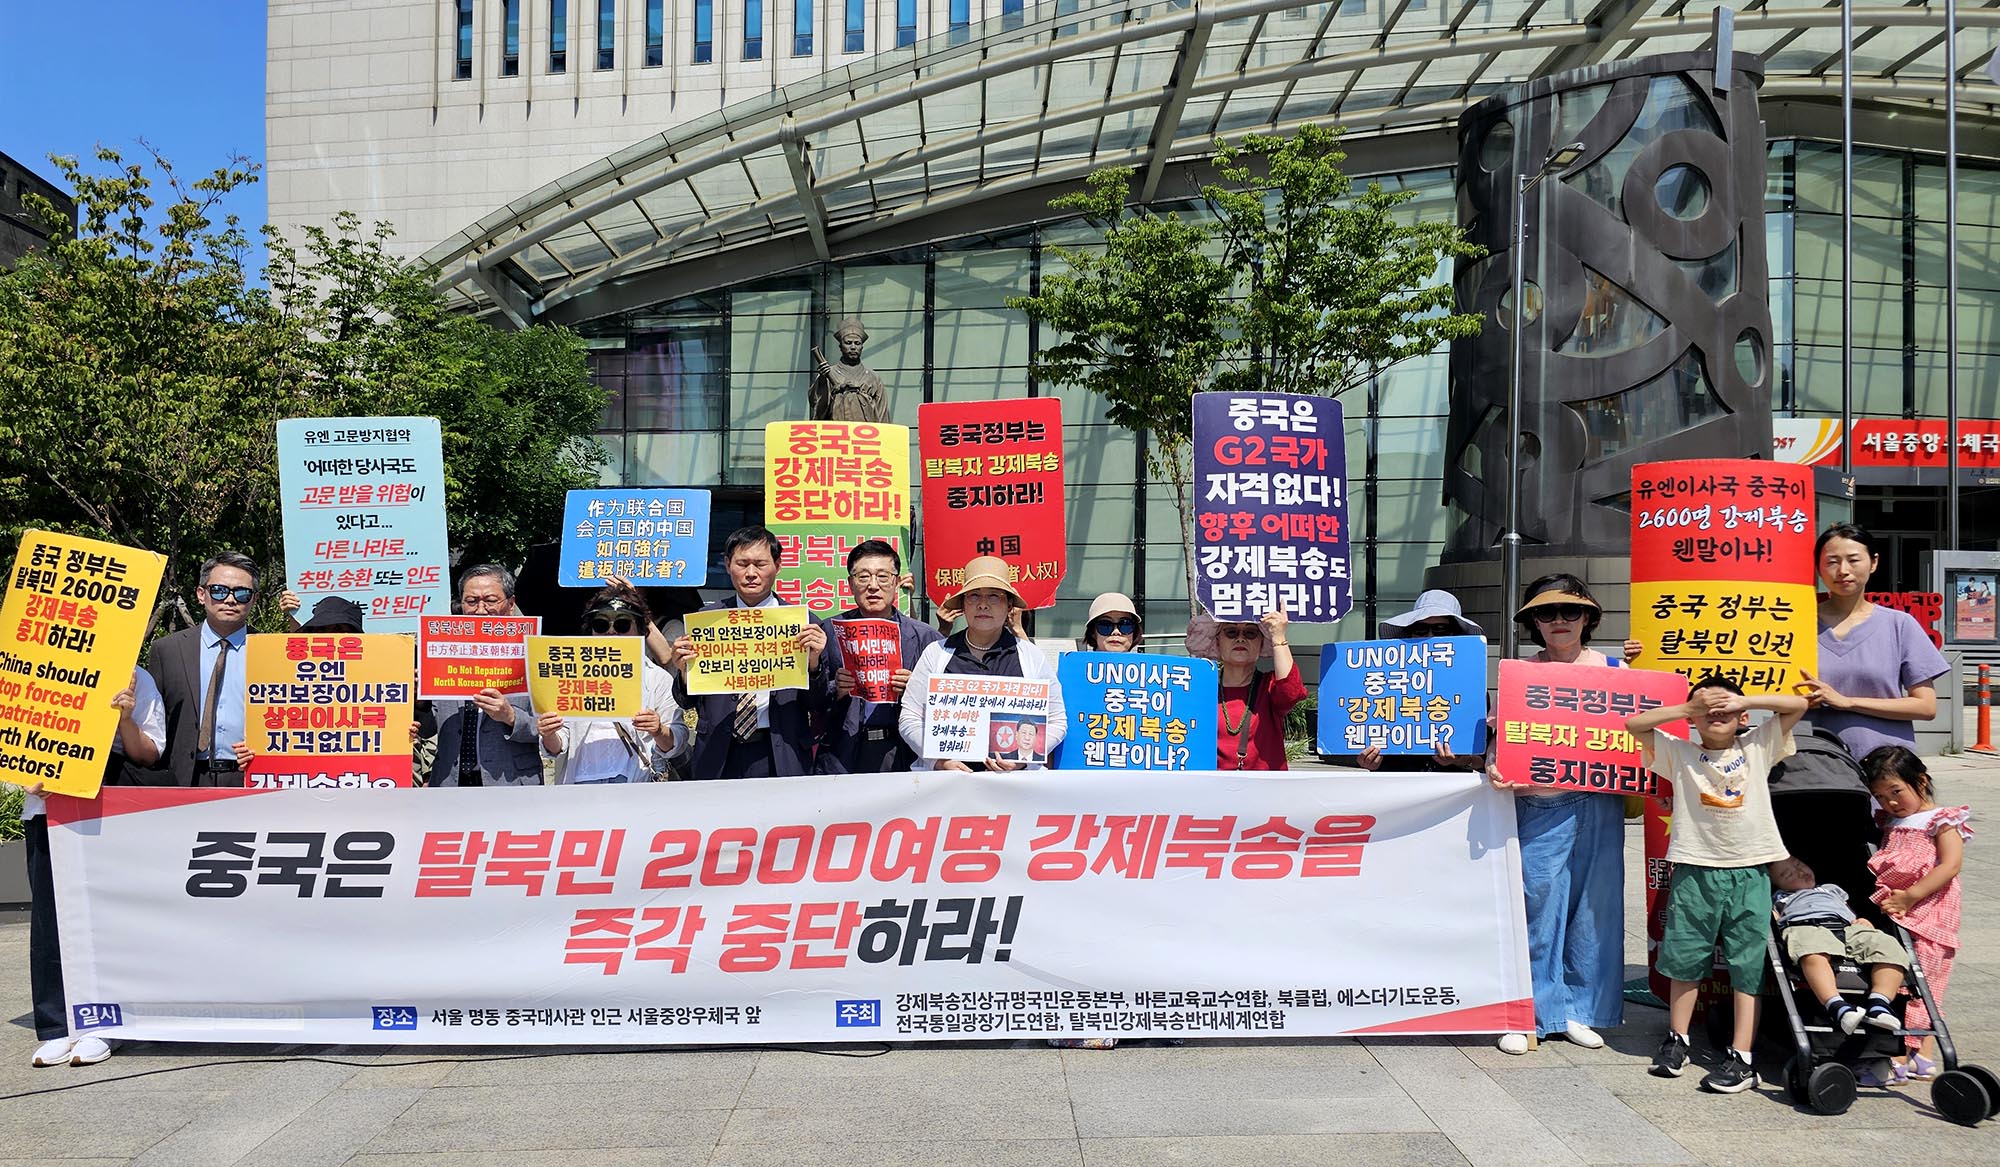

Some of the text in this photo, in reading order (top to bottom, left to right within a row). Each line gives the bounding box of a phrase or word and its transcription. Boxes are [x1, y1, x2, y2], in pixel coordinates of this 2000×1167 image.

[1228, 399, 1318, 433] 중국은
[304, 428, 411, 444] 유엔 고문방지협약
[789, 424, 881, 455] 중국은
[939, 420, 1046, 446] 중국정부는
[1773, 437, 1796, 449] OST
[1863, 432, 2000, 453] 서울중앙체국
[1213, 435, 1328, 470] G2 국가
[355, 458, 417, 475] 당사국도
[774, 458, 893, 489] 강제북송
[925, 453, 1060, 480] 탈북자 강제북송
[299, 484, 425, 506] 고문 받을 위험이
[947, 484, 1044, 510] 중지하라!
[1205, 473, 1341, 508] 자격없다!
[1636, 476, 1807, 502] 유엔이사국 중국이
[587, 499, 685, 518] 作为联合国
[774, 490, 901, 521] 중단하라!
[575, 519, 695, 538] 会员国的中国
[1199, 512, 1340, 544] 향후 어떠한
[1638, 504, 1808, 534] 2600명 강제북송
[314, 540, 352, 558] 다른
[977, 535, 1021, 557] 中国
[1672, 538, 1772, 564] 웬말이냐!
[32, 543, 127, 582] 중국 정부는
[1200, 545, 1348, 580] 강제북송도
[374, 570, 404, 585] 또는
[407, 565, 441, 585] 인도
[14, 567, 140, 610] 탈북민 2600명
[25, 593, 98, 629] 강제북송
[372, 596, 389, 615] 안
[728, 610, 763, 624] 중국은
[1652, 594, 1794, 621] 중국 정부는
[15, 618, 97, 653] 중지하라!
[691, 624, 801, 641] 유엔 안전보장이사회
[859, 625, 878, 638] 국가
[1659, 628, 1794, 657] 탈북민 인권
[286, 637, 363, 661] 중국은
[428, 643, 525, 657] 中方停止遣返朝鲜难
[548, 646, 621, 662] 중국 정부는
[754, 642, 778, 656] 자격
[860, 639, 880, 653] 시민
[1346, 643, 1455, 671] UN이사국
[36, 661, 101, 689] should
[295, 661, 346, 682] 유엔
[447, 666, 457, 674] Do
[460, 666, 472, 675] Not
[538, 662, 634, 678] 탈북민 2600명
[699, 656, 795, 674] 안보리 상임이사국
[1086, 662, 1191, 691] UN이사국
[0, 677, 88, 711] top forced
[248, 682, 409, 705] 안전보장이사회
[434, 677, 523, 689] North Korean Refugees!
[558, 679, 613, 695] 강제북송
[724, 675, 775, 690] 사퇴하라!
[937, 680, 1043, 696] 중국은 G2 국가 자격 없다!
[1364, 669, 1433, 695] 중국이
[557, 696, 615, 713] 중지하라!
[928, 694, 1047, 711] 전 세계 시민 앞에서 사과하라!
[1104, 688, 1172, 716] 중국이
[1338, 694, 1461, 725] '강제북송'
[262, 706, 387, 729] 상임이사국
[933, 709, 980, 722] 향후 어떠한
[932, 724, 976, 738] 강제북송도
[1078, 713, 1196, 744] '강제북송'
[1344, 723, 1454, 750] 웬말이냐?
[1505, 720, 1579, 748] 탈북자
[25, 730, 95, 761] Korean
[266, 731, 381, 754] 자격없다!
[1083, 741, 1190, 770] 웬말이냐?
[1529, 756, 1658, 795] 중지하라!
[186, 813, 1378, 899] 중국은 탈북민 2600여명 강제북송을
[563, 896, 1025, 976] 즉각 중단하라!
[896, 986, 1461, 1012] 강제북송진상규명국민운동본부, 바른교육교수연합, 북클럽, 에스더기도운동,
[79, 1005, 117, 1026] 일시
[377, 1006, 762, 1027] 장소 서울 명동 중국대사관 인근 서울중앙우체국 앞
[841, 1003, 876, 1024] 주최
[896, 1010, 1286, 1034] 전국통일광장기도연합, 탈북민강제북송반대세계연합
